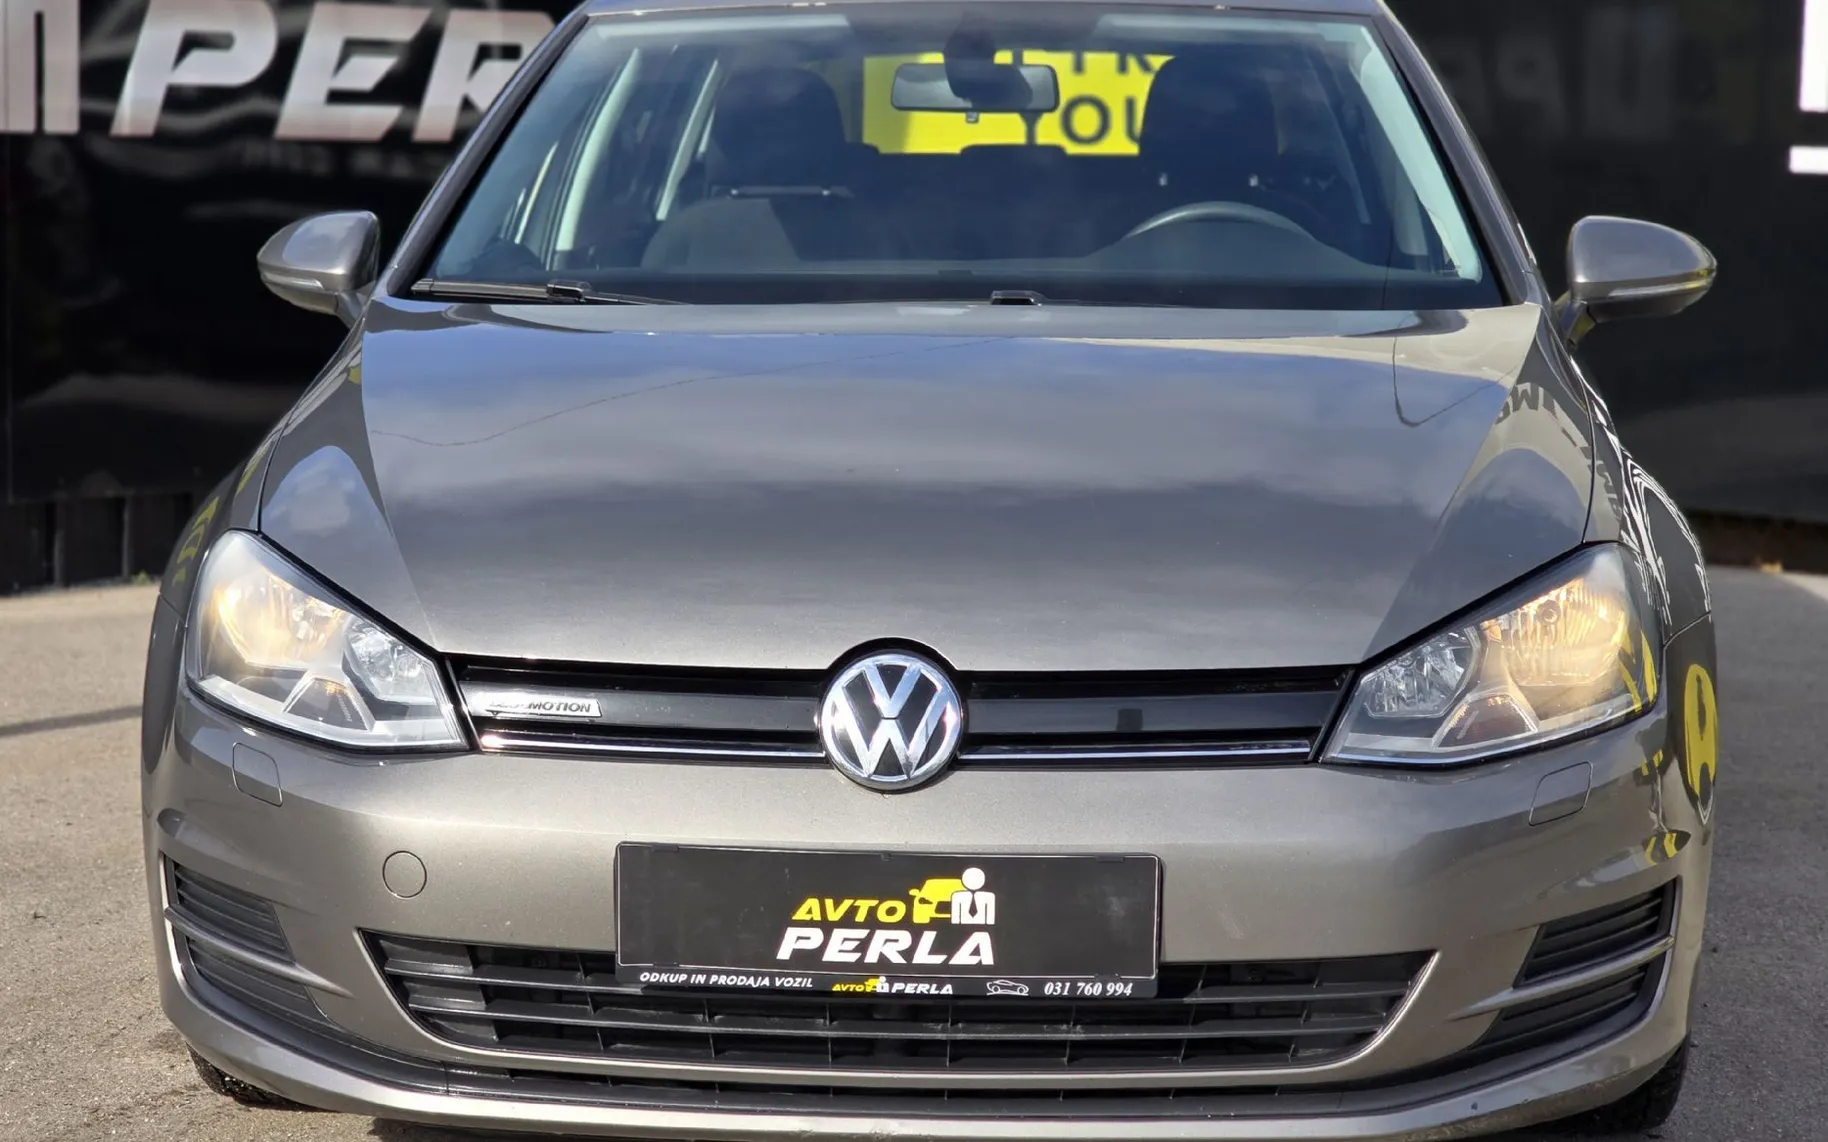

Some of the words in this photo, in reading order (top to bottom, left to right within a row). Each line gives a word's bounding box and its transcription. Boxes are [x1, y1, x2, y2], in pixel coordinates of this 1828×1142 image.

[791, 897, 907, 924] AVTO
[775, 926, 995, 966] PERLA
[639, 972, 687, 984] ODKUP
[690, 974, 707, 985] IN
[709, 975, 770, 988] PRODAJA
[775, 977, 813, 988] VOZIL
[832, 983, 866, 992] AVTO
[891, 982, 953, 995] PERLA
[1044, 982, 1071, 996] 031
[1076, 982, 1103, 996] 760
[1106, 982, 1134, 996] 994
